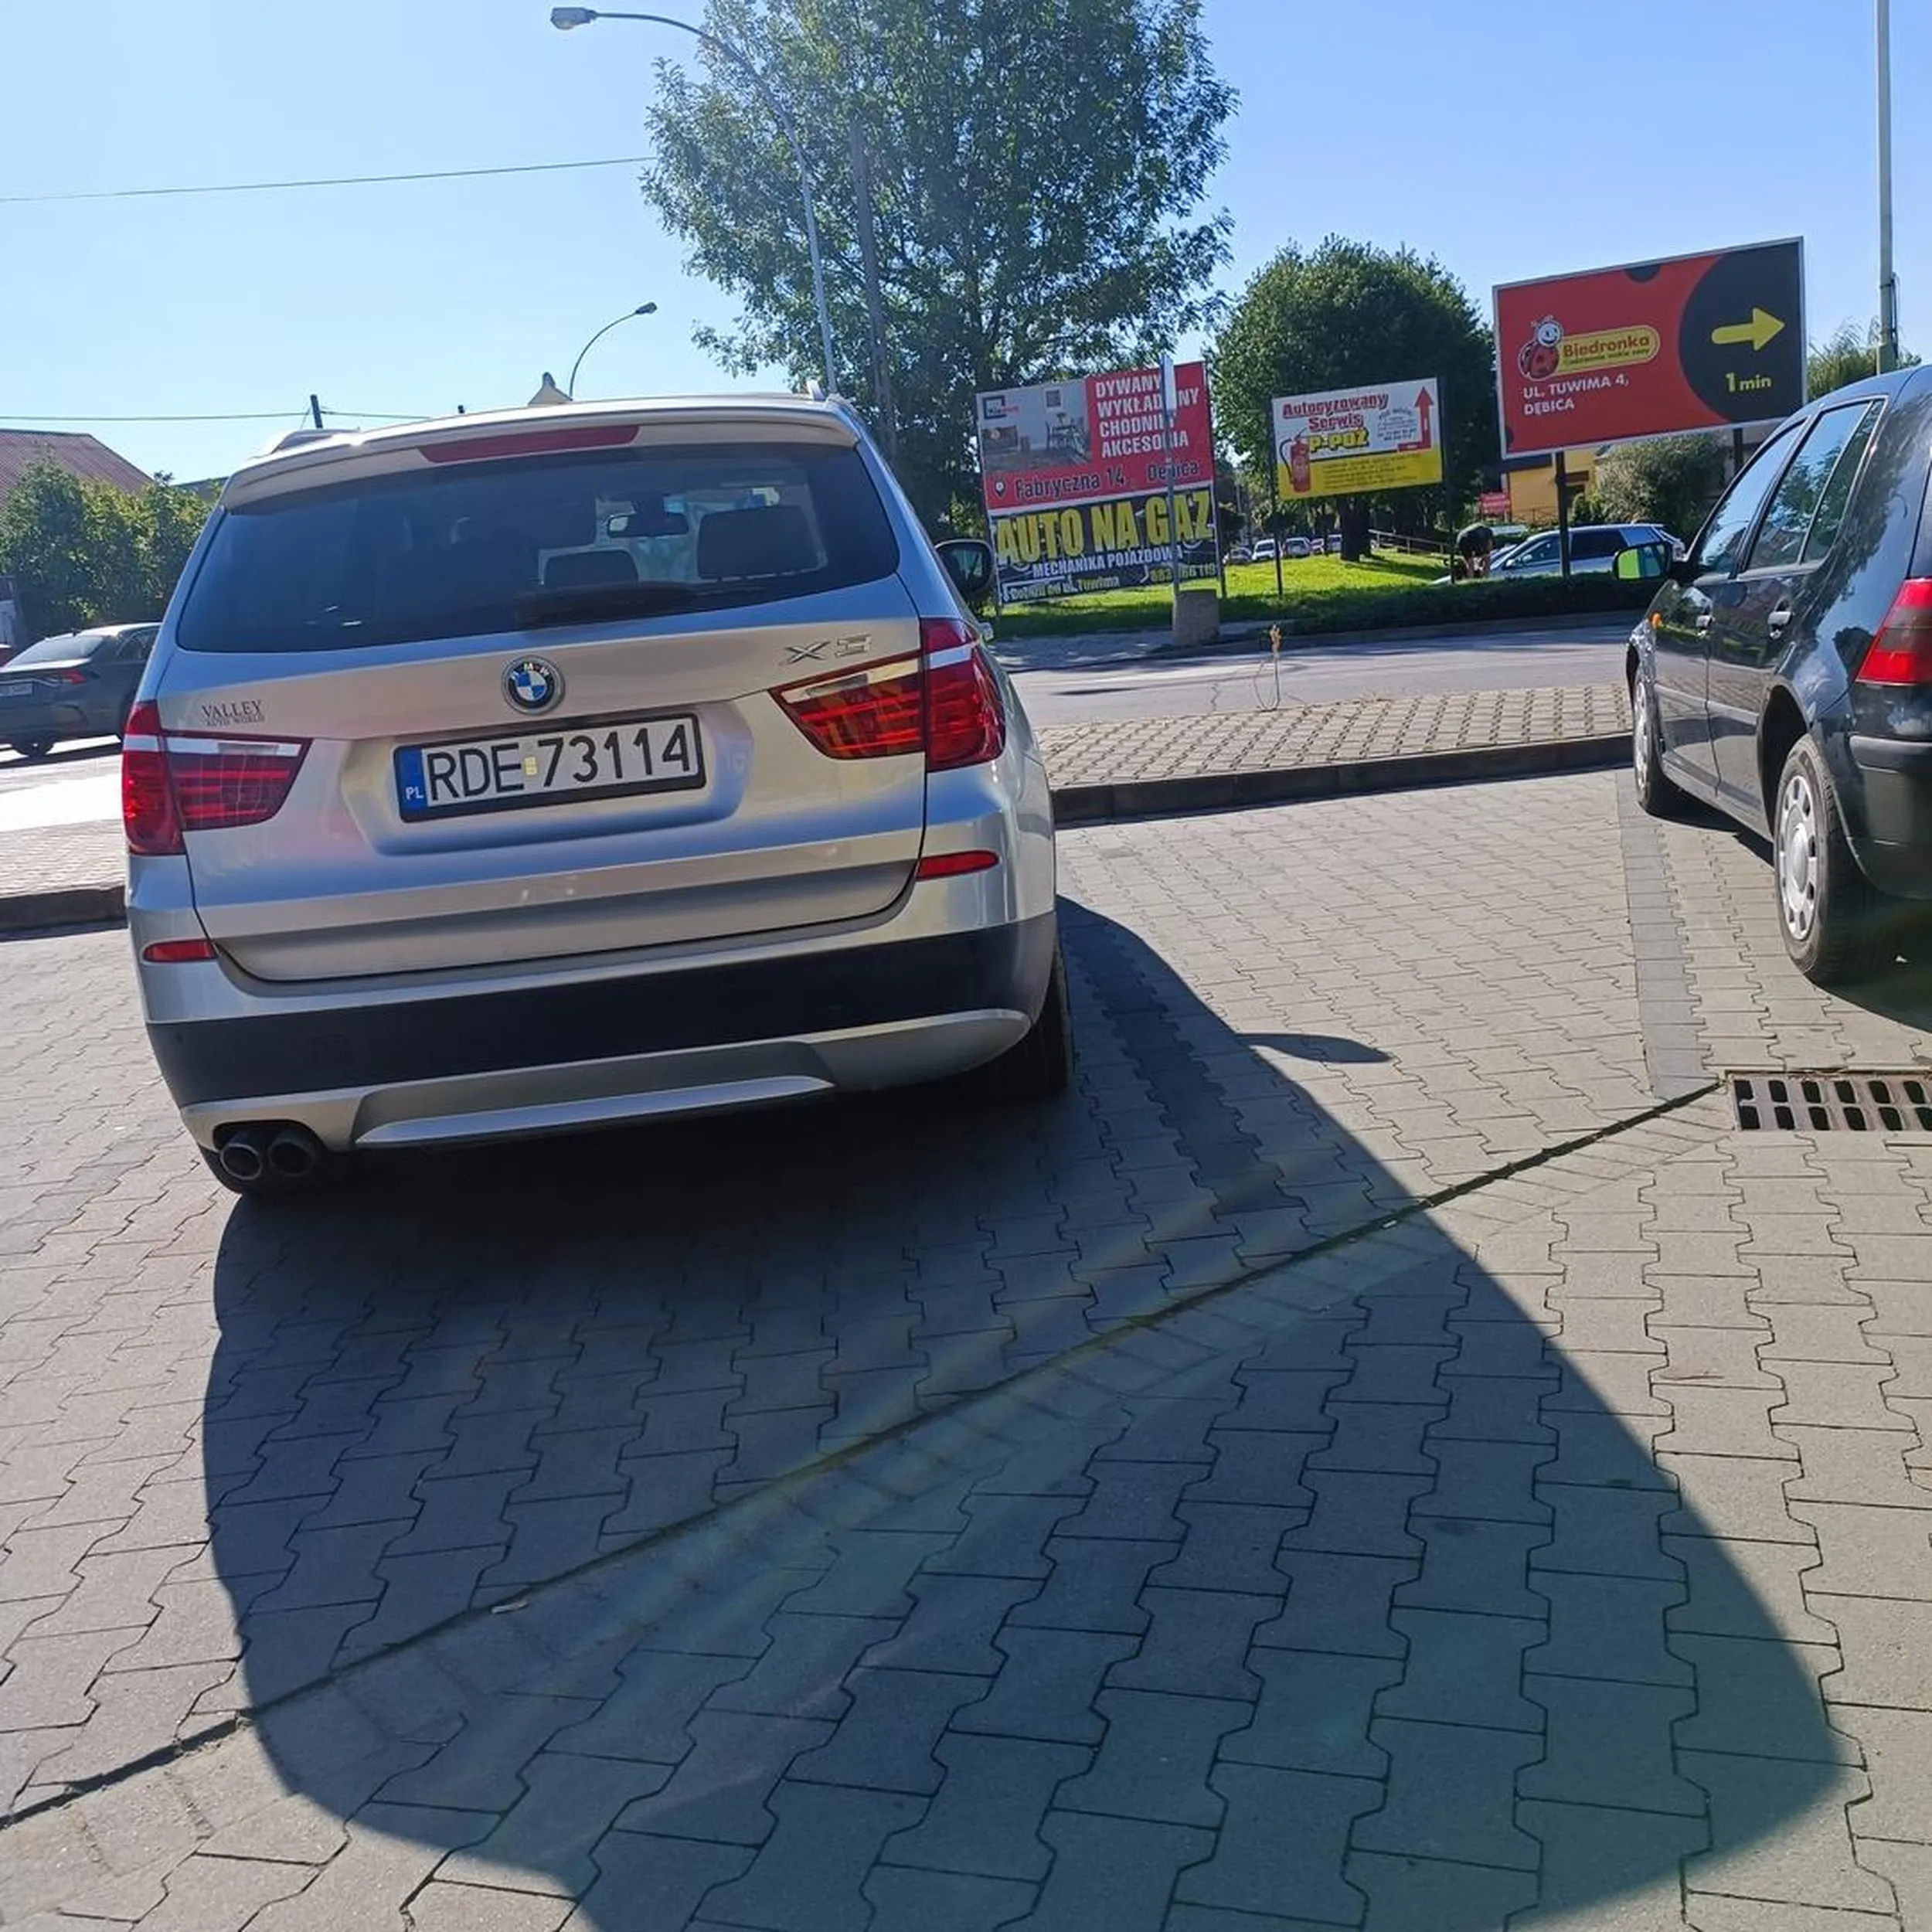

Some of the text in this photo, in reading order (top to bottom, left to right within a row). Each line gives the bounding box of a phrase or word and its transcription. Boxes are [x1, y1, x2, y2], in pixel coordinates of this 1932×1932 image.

[1563, 335, 1650, 357] Biedronka
[1095, 374, 1162, 399] DYWANY
[1523, 373, 1629, 400] UL. TUWIMA 4,
[1725, 372, 1772, 393] 1 min
[1097, 387, 1199, 419] WYKŁADNY
[1308, 413, 1363, 431] Serwis
[1015, 473, 1101, 499] Fabryczna
[996, 491, 1213, 564] AUTO NA GAZ
[1032, 555, 1106, 578] MECHANIKA
[783, 633, 872, 664] X3
[201, 699, 262, 717] VALLEY
[426, 724, 692, 801] RDE 73114
[405, 786, 424, 801] PL
